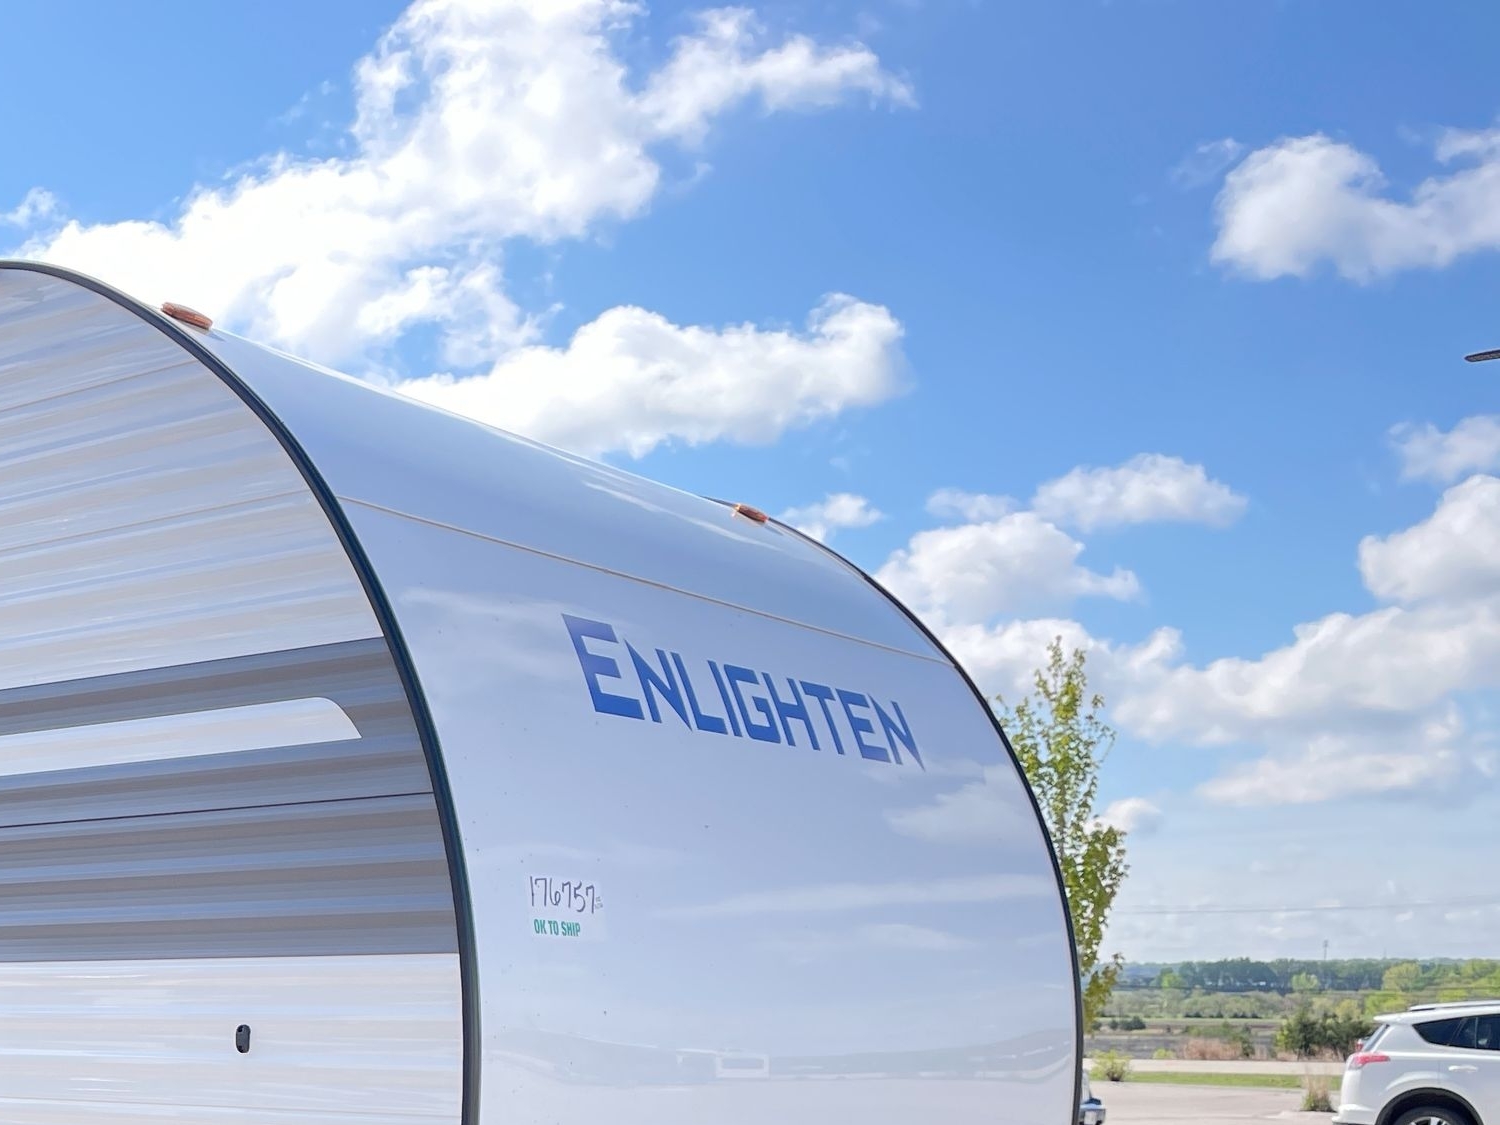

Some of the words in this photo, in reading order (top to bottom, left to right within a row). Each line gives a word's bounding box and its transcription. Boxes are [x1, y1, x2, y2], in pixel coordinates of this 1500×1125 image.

[562, 613, 925, 772] ENLIGHTEN
[530, 876, 594, 914] 176757
[534, 919, 546, 935] OK
[548, 920, 559, 936] TO
[561, 921, 581, 937] SHIP
